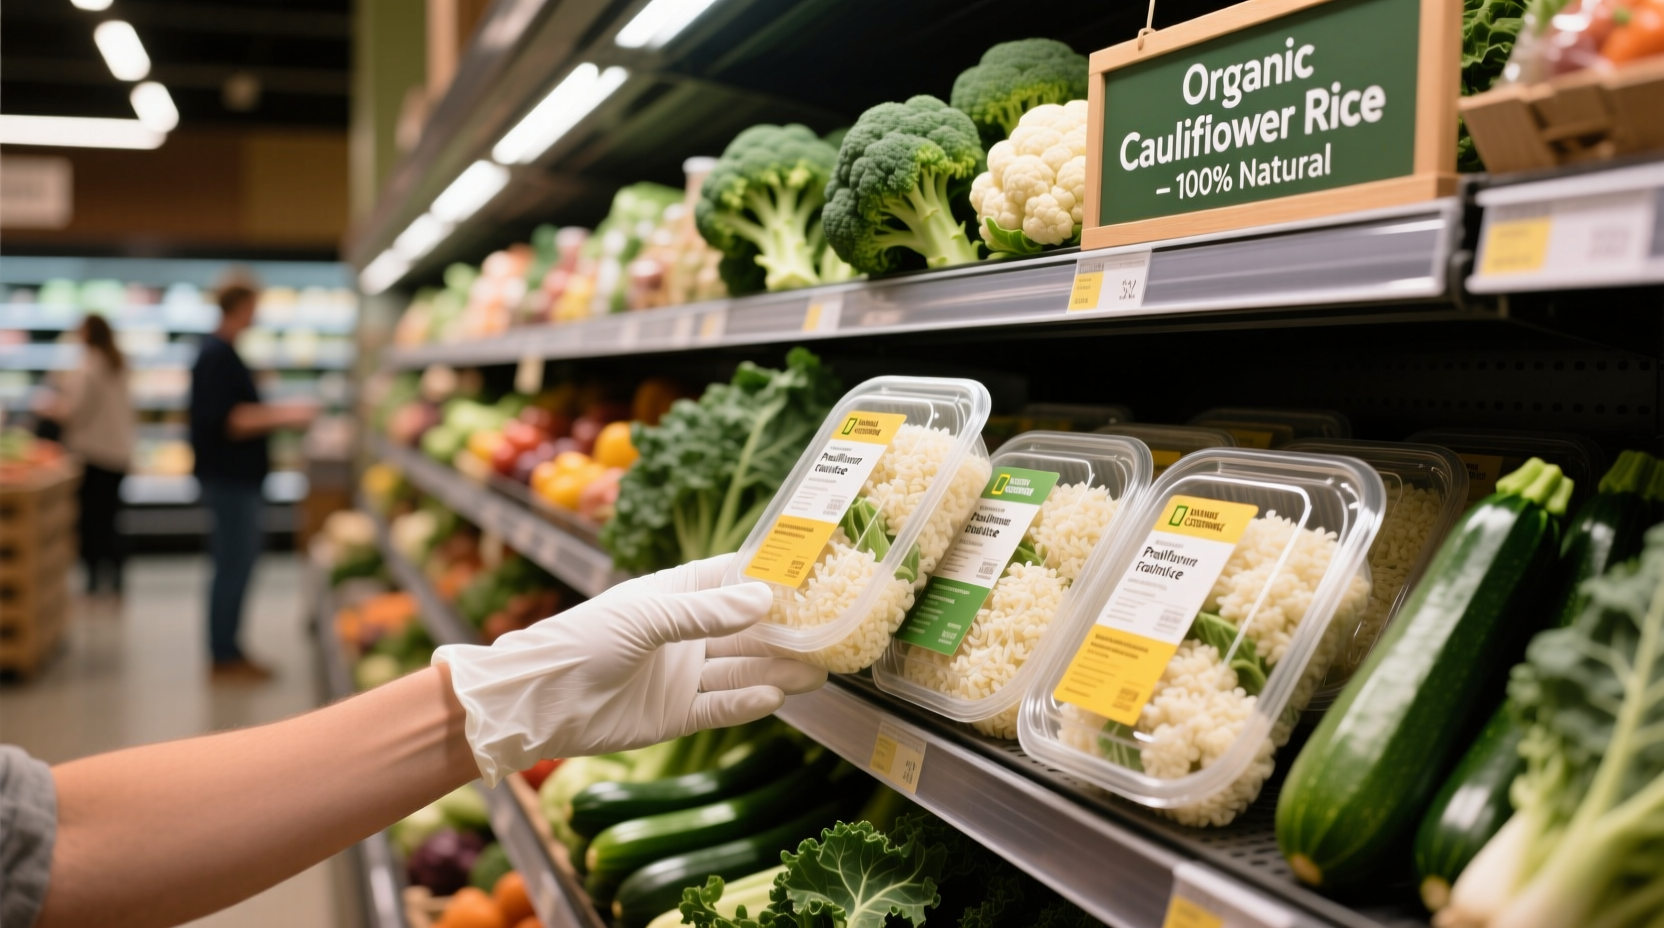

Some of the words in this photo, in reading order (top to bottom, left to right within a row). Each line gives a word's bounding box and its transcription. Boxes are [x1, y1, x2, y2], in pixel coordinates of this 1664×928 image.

[1182, 36, 1315, 109] Organic
[1304, 81, 1386, 135] Rice
[1175, 163, 1233, 200] 100%
[1239, 142, 1331, 190] Natural
